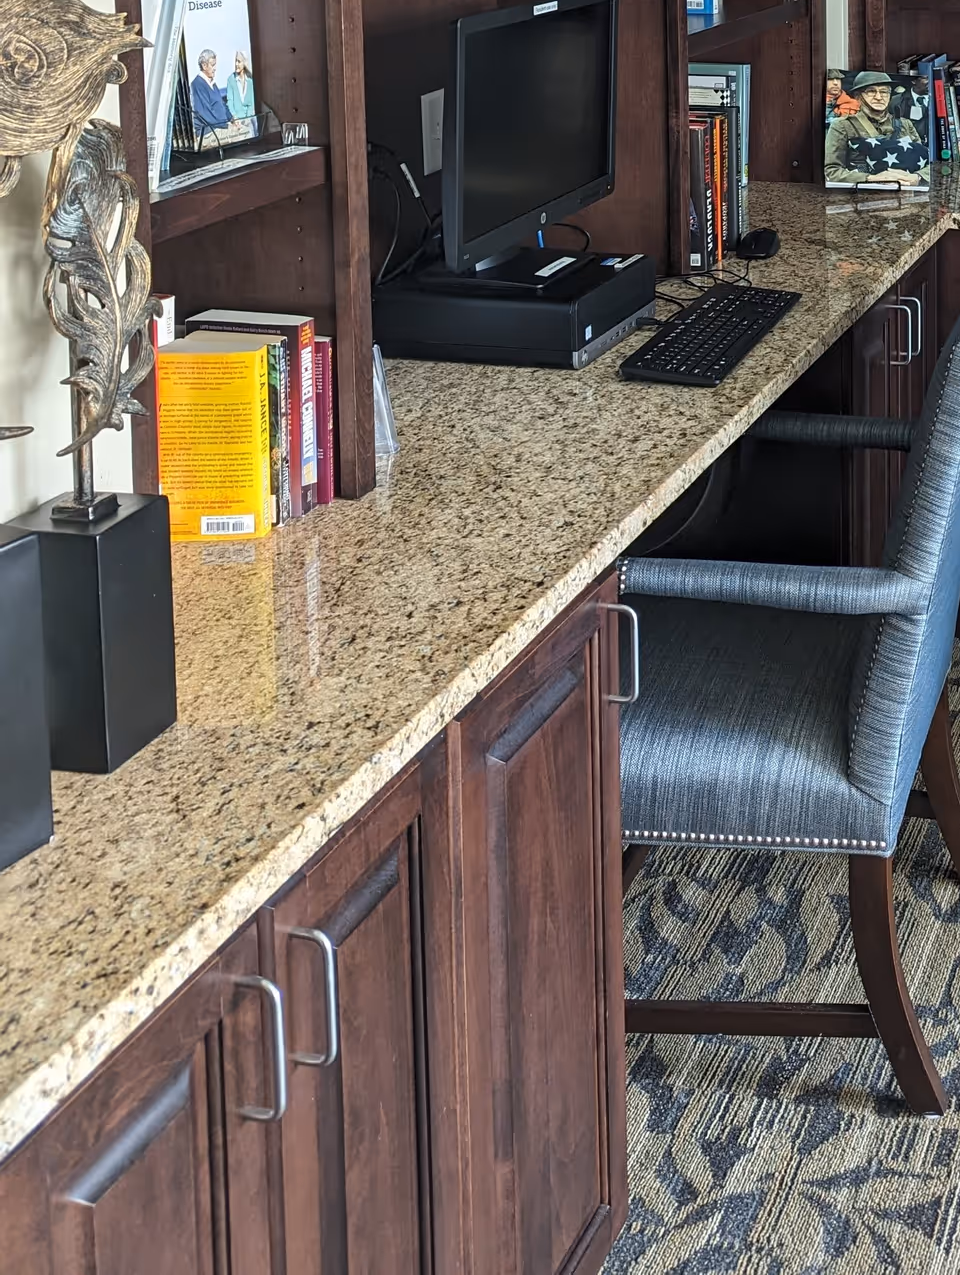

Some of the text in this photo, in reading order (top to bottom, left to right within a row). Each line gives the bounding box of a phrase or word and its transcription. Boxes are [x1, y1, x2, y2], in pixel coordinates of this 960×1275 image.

[188, 0, 222, 11] Disease
[259, 372, 268, 436] J.A. JANCE
[301, 345, 314, 458] MICHAEL CONNELLY
